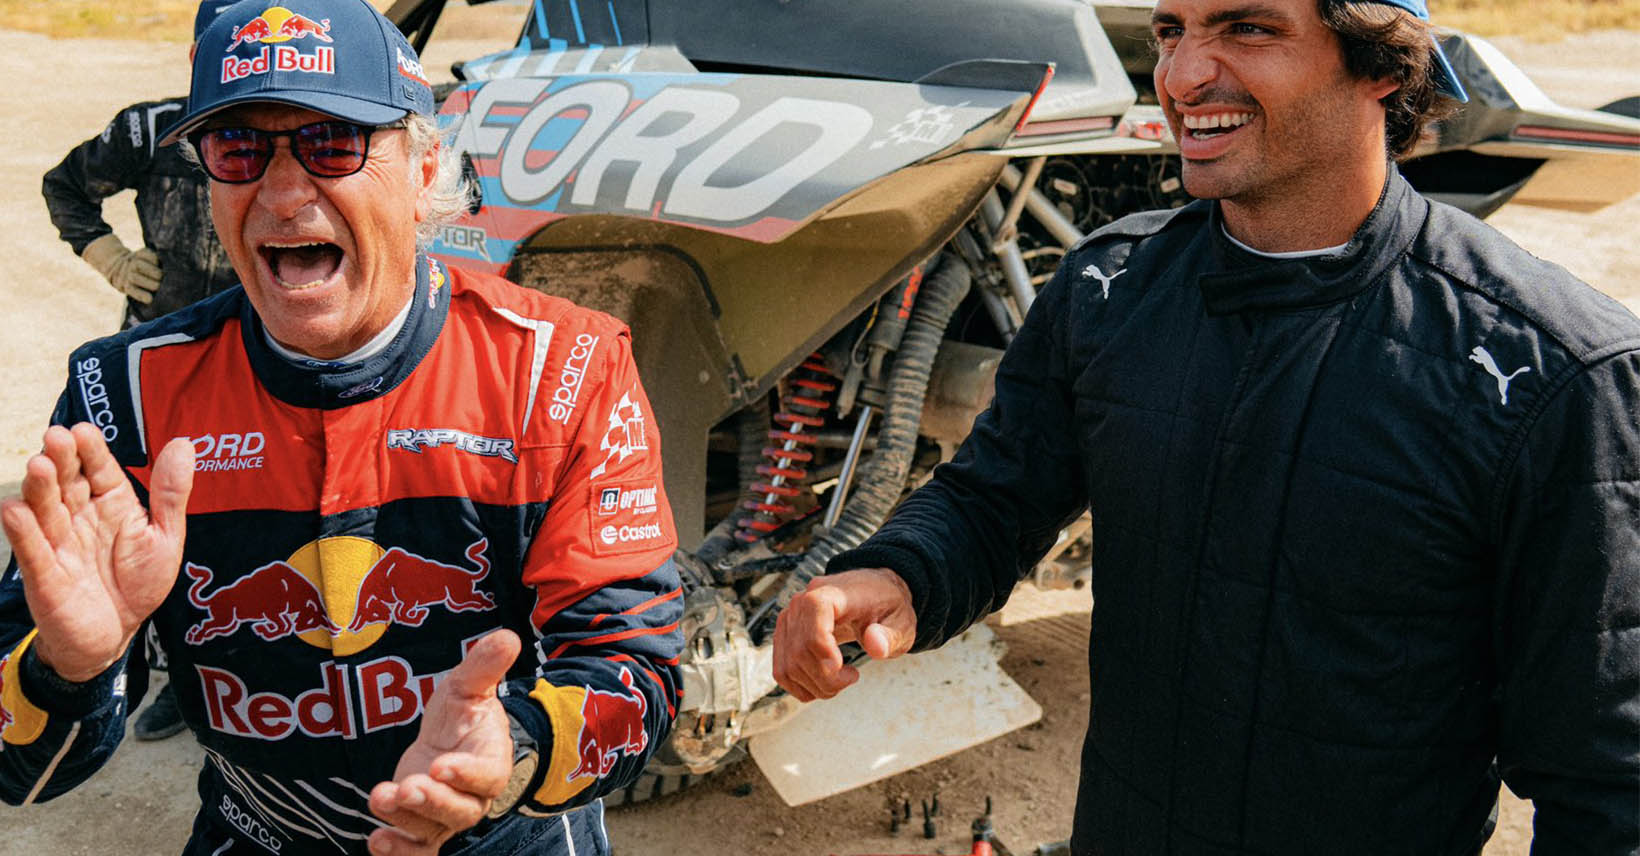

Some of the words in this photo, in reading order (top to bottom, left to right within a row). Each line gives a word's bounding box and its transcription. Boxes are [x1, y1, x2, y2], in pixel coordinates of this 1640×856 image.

[221, 46, 271, 84] Red
[275, 46, 335, 75] Bull
[453, 79, 873, 221] FORD
[440, 225, 492, 264] TOR
[550, 334, 597, 423] sparco
[76, 357, 118, 442] sparco
[173, 431, 265, 458] ORD
[194, 456, 264, 472] ORMANCE
[387, 428, 519, 463] RAPTOR
[619, 521, 661, 542] Castrol
[194, 660, 357, 741] Red
[219, 794, 282, 855] sparco
